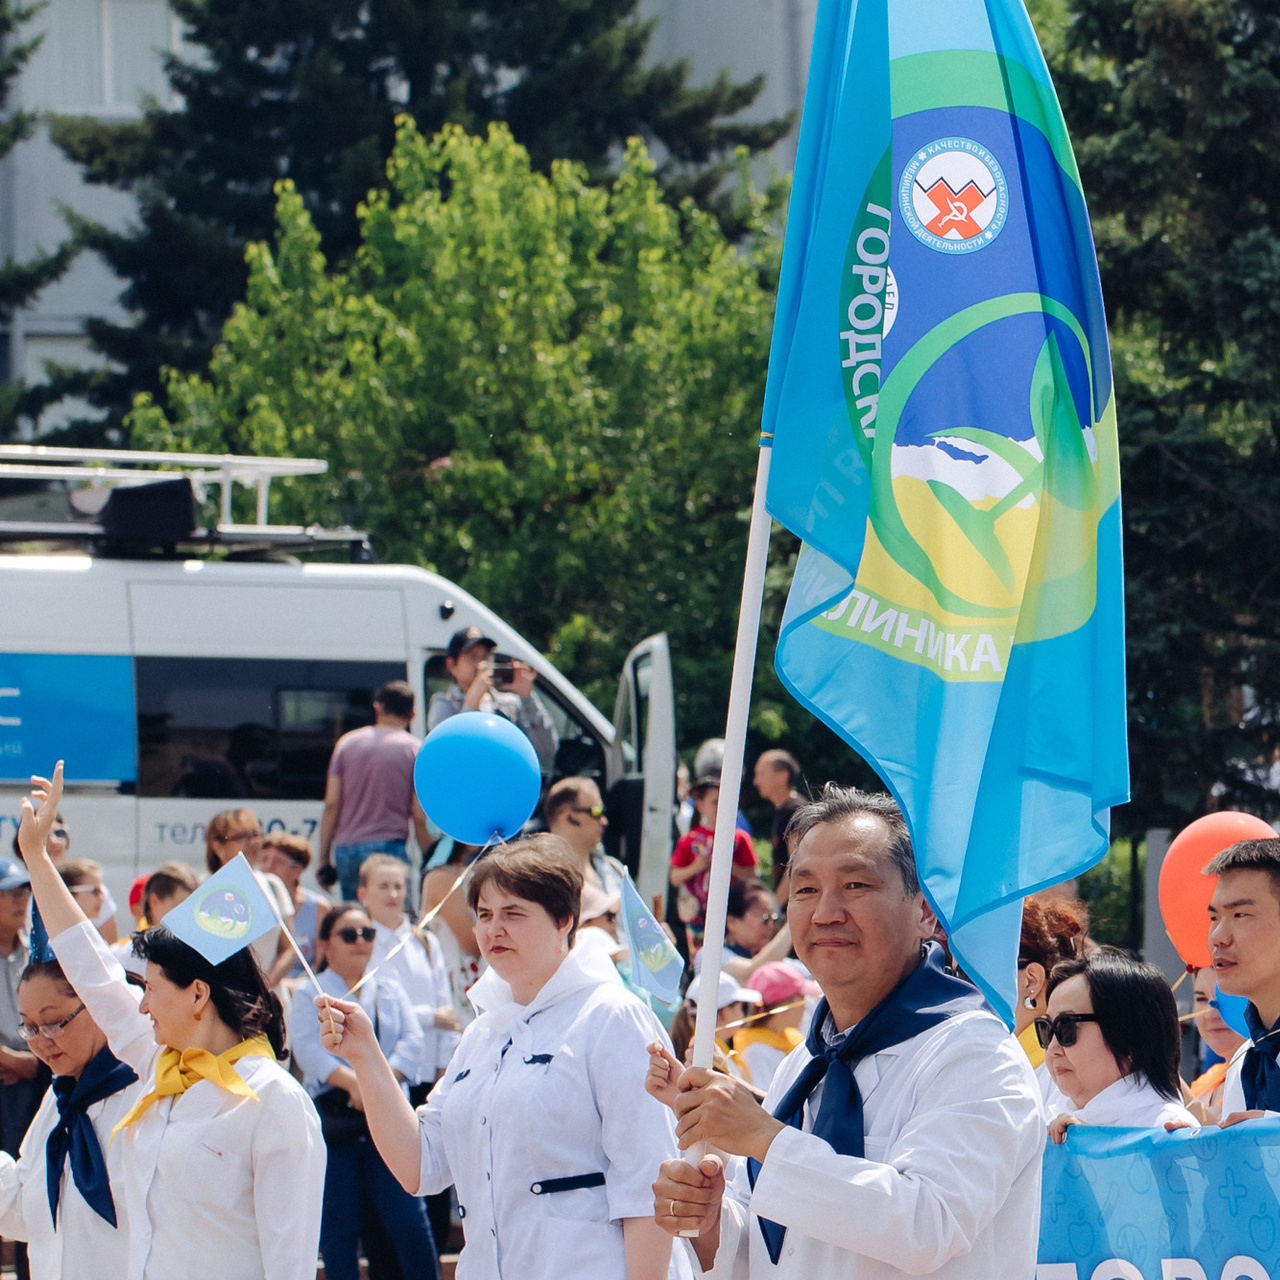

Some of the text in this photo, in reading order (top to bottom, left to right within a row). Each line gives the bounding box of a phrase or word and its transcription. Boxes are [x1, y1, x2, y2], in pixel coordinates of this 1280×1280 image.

[901, 160, 985, 251] МЕДИЦИНСКОЙ ДЕЯТЕЛЬНОСТИ
[927, 139, 1007, 231] КАЧЕСТВО И БЕЗОПАСНОСТЬ
